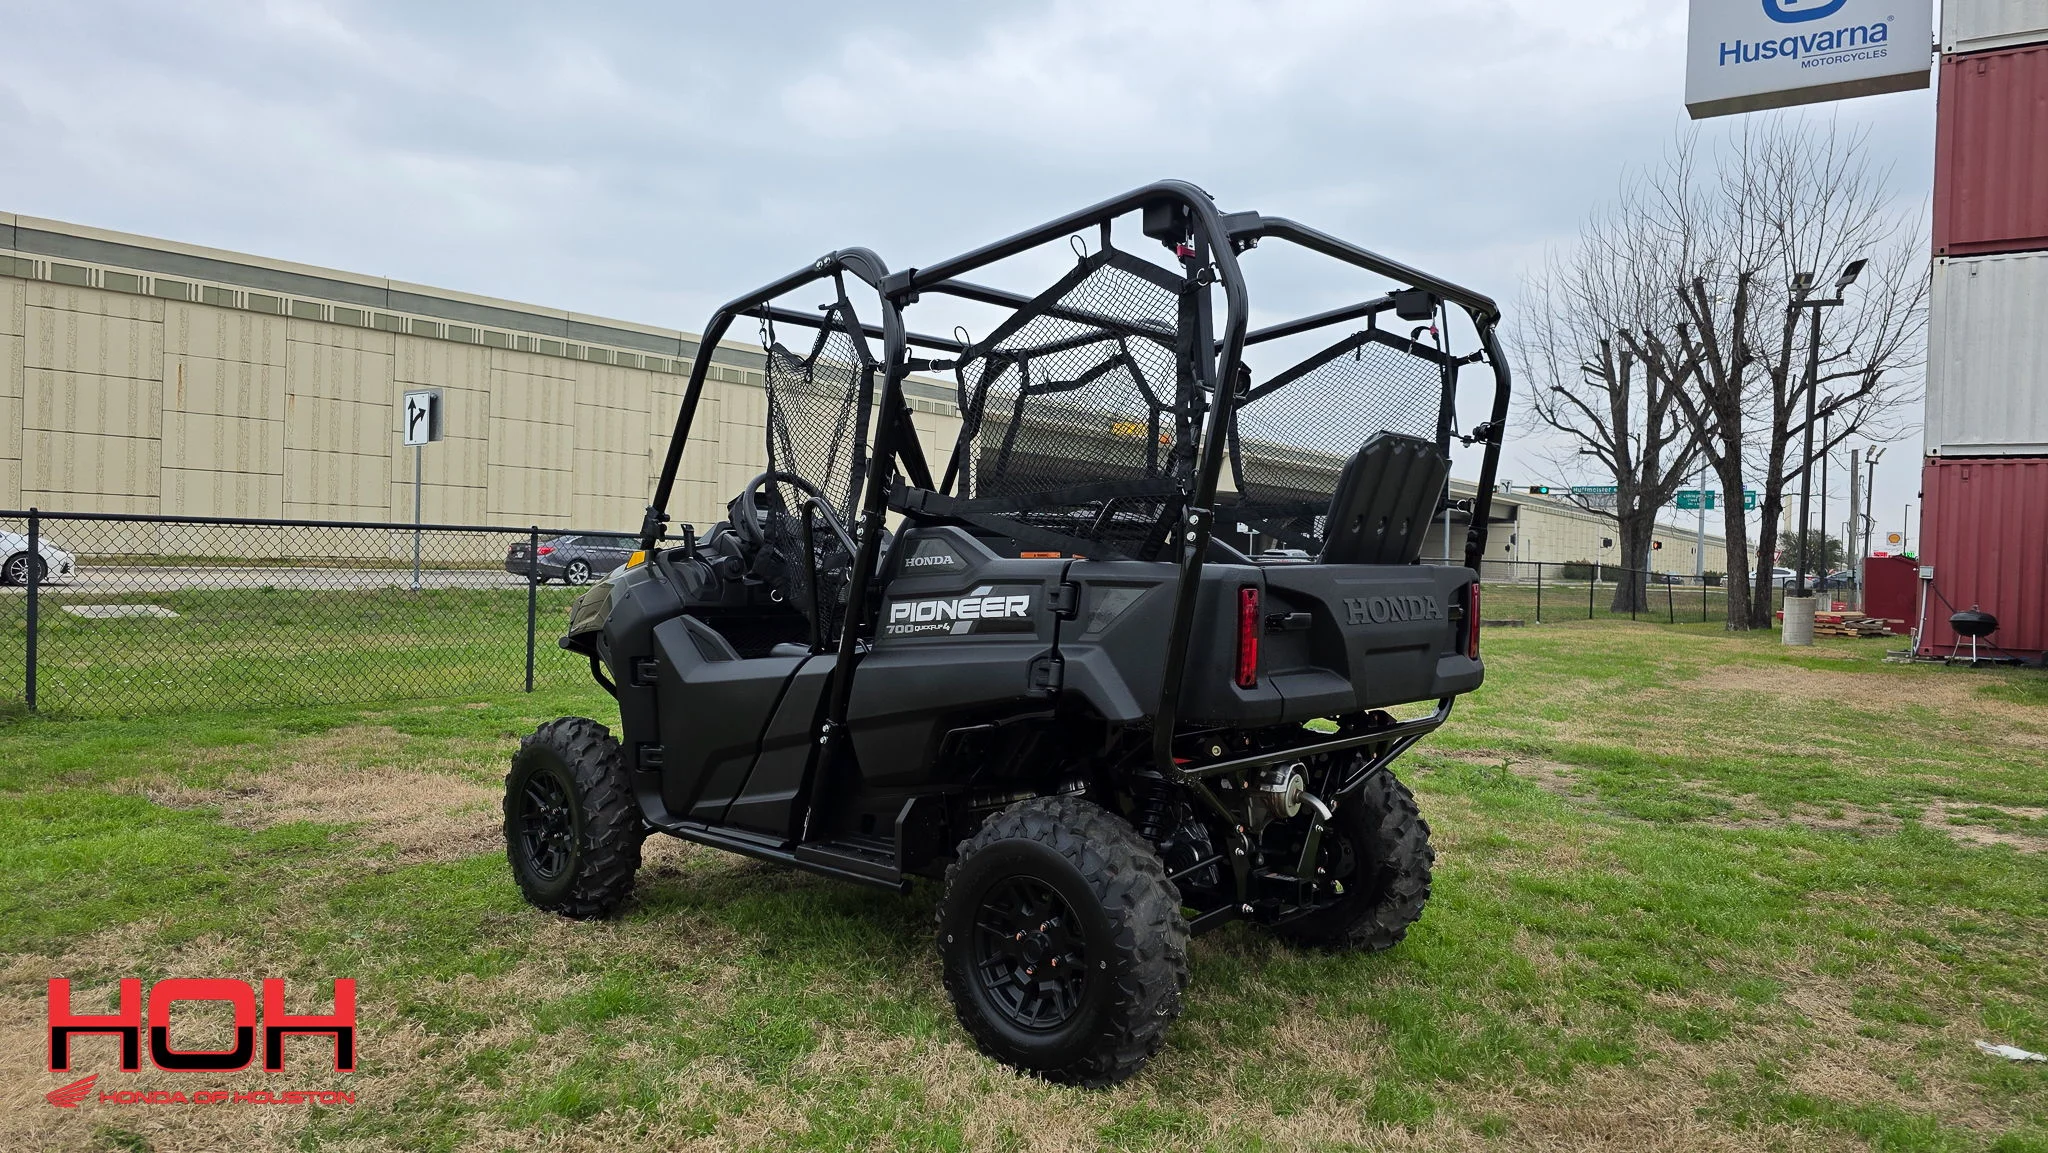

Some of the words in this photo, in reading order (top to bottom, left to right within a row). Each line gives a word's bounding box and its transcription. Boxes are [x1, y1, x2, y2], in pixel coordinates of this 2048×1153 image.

[1719, 22, 1887, 66] Husqvarna
[1801, 49, 1887, 68] MOTORCYCLES
[906, 556, 954, 567] HONDA
[890, 595, 1030, 623] PIONEER
[1344, 595, 1443, 625] HONDA
[886, 625, 914, 634] 700
